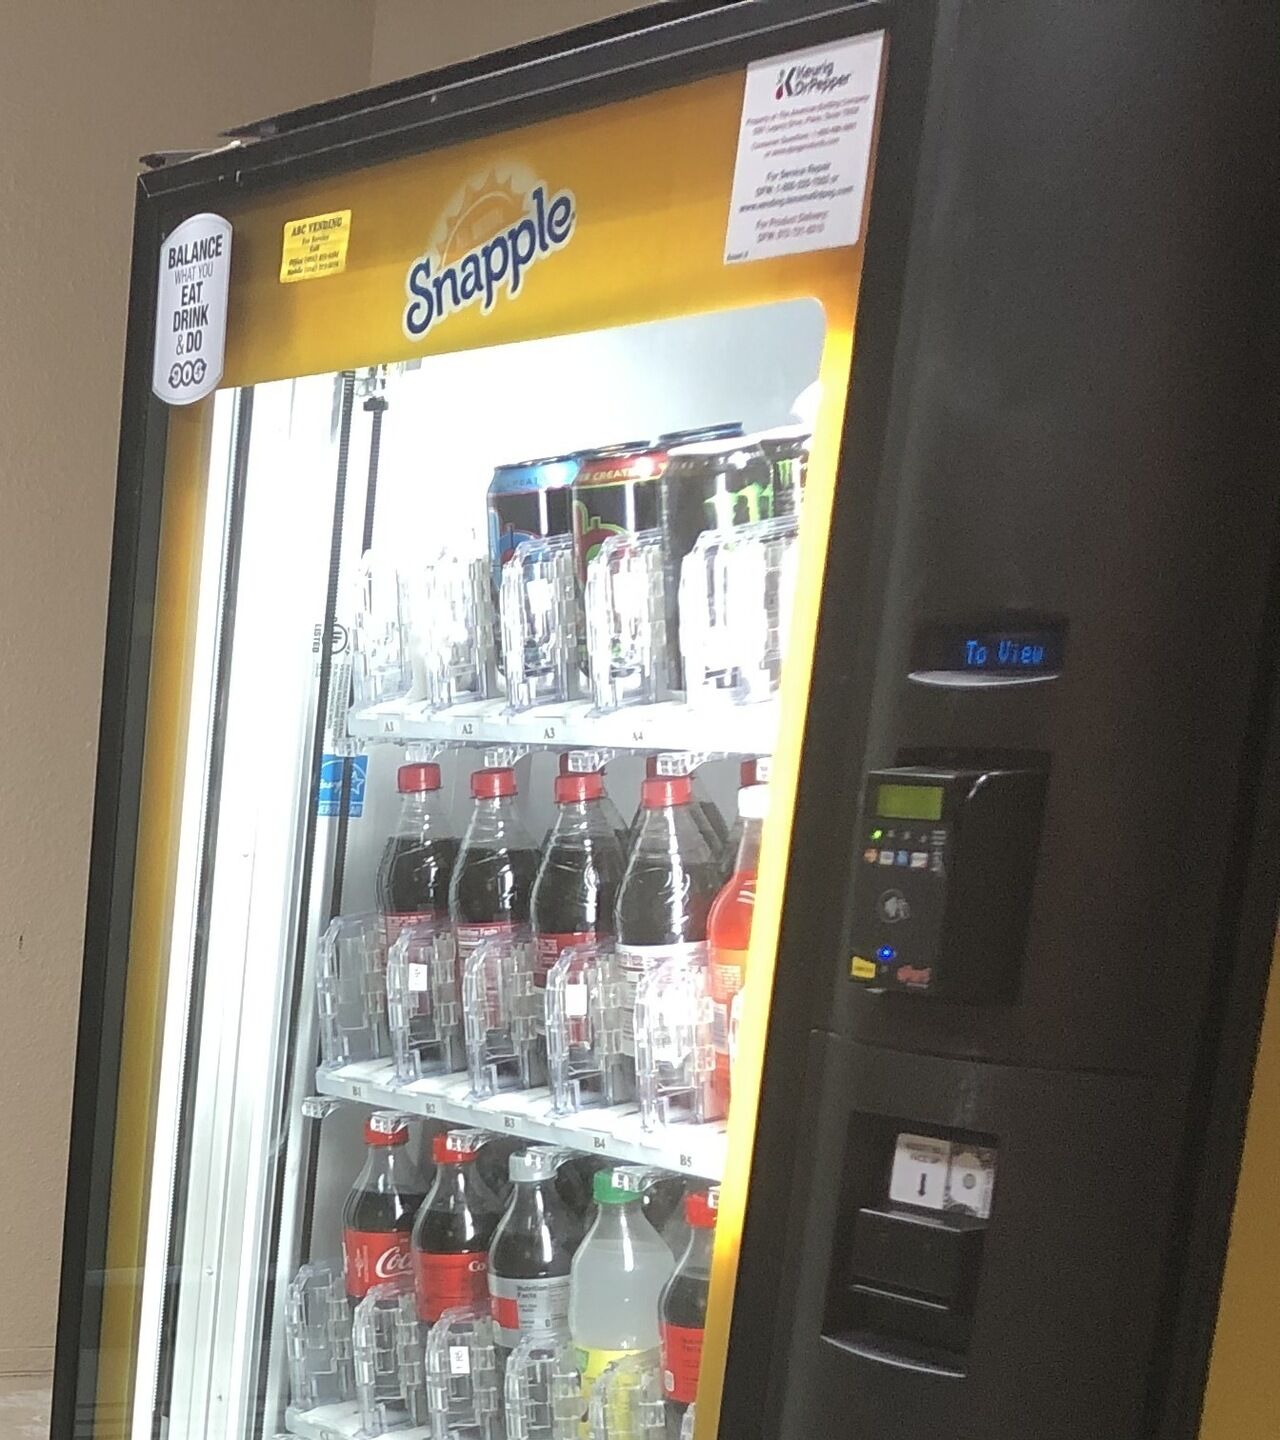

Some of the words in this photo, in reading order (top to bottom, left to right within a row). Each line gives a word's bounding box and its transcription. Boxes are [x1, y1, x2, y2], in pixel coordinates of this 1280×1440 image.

[168, 233, 224, 270] BALANCE
[406, 186, 572, 334] Snapple
[174, 265, 196, 285] WHAT
[198, 260, 214, 280] YOU
[173, 303, 210, 333] DRINK
[175, 334, 185, 356] &
[185, 330, 203, 354] DO
[311, 623, 323, 654] LISTED
[966, 640, 987, 665] To
[462, 722, 474, 736] A2
[543, 726, 556, 740] A3
[351, 1085, 363, 1098] B1
[425, 1101, 438, 1115] B2
[503, 1115, 517, 1130] B3
[592, 1135, 607, 1150] B4
[678, 1152, 694, 1169] B5
